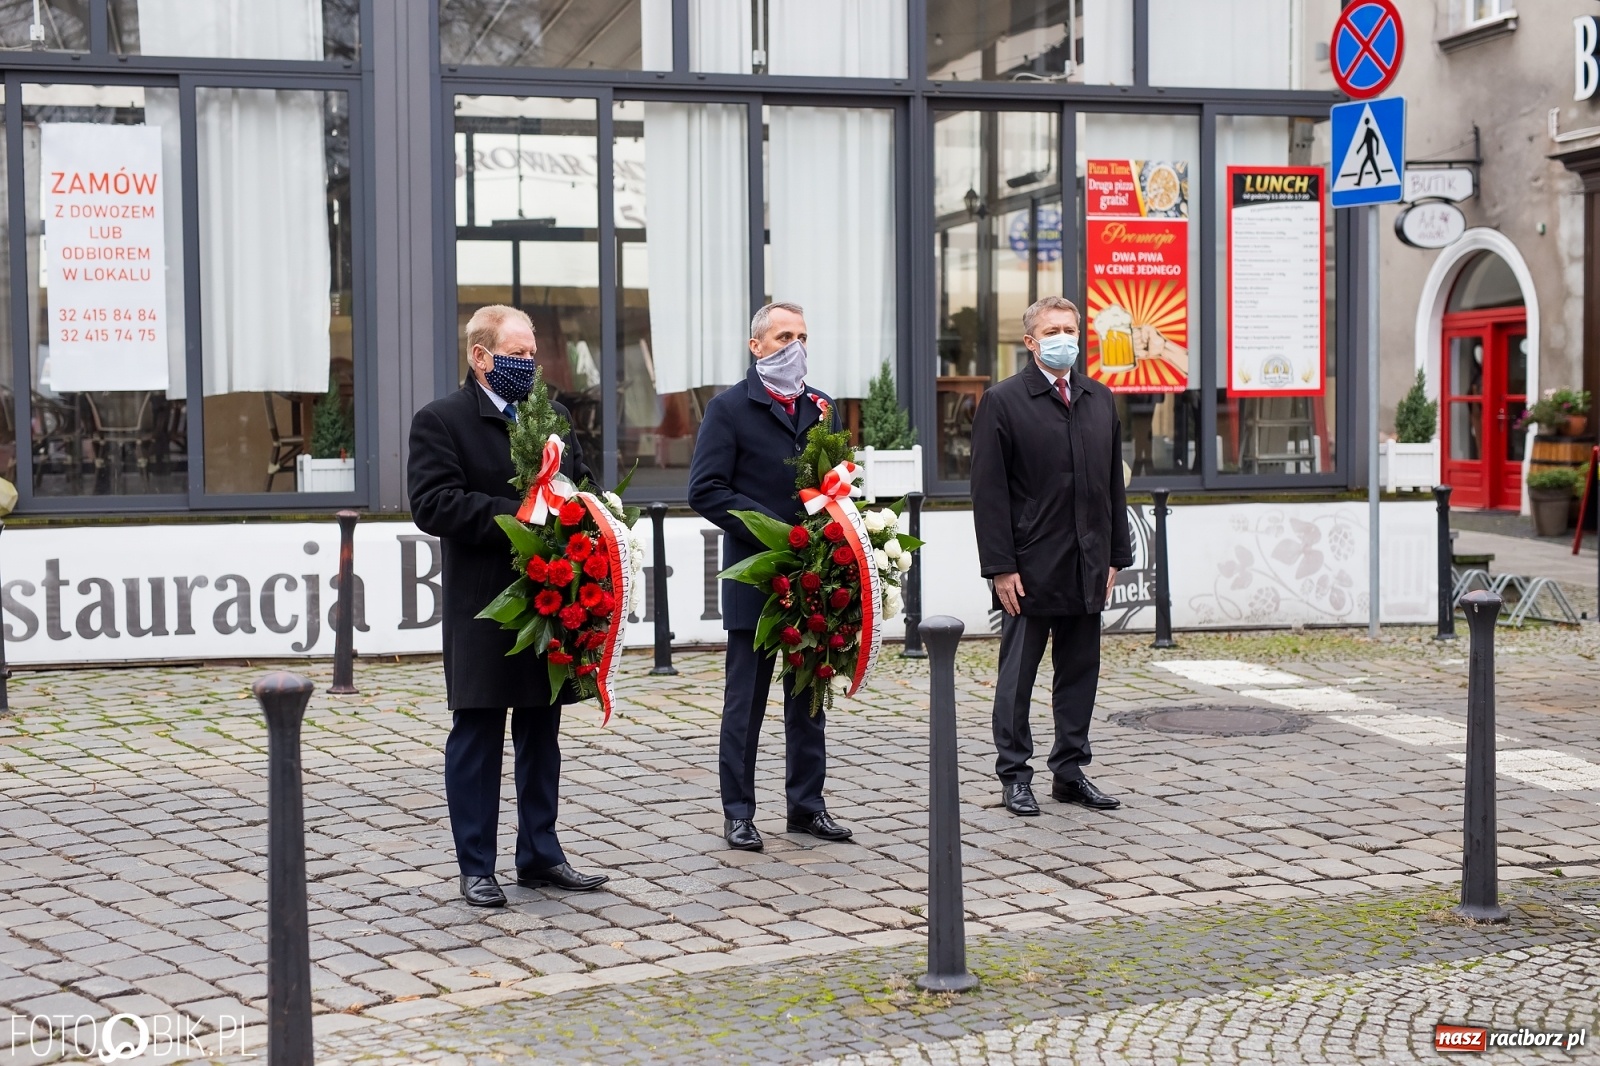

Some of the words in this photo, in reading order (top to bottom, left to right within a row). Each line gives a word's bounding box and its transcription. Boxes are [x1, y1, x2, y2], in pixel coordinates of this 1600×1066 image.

[1088, 162, 1109, 175] Pizza
[1109, 162, 1131, 175] Time
[51, 167, 157, 195] ZAMÓW
[1088, 178, 1114, 194] Druga
[1115, 178, 1134, 194] pizza
[1245, 174, 1309, 193] LUNCH
[1411, 174, 1457, 195] BUTIK
[1100, 192, 1129, 211] gratis!
[55, 204, 64, 218] Z
[70, 204, 155, 219] DOWOZEM
[89, 226, 122, 239] LUB
[1101, 222, 1176, 250] Promocja
[62, 246, 150, 260] ODBIOREM
[1112, 251, 1136, 263] DWA
[1138, 251, 1164, 263] PIWA
[62, 267, 78, 281] W
[84, 267, 151, 282] LOKALU
[1094, 264, 1105, 275] W
[1106, 264, 1135, 275] CENIE
[1136, 264, 1182, 276] JEDNEGO
[59, 308, 77, 322] 32
[83, 308, 107, 322] 415
[113, 308, 132, 322] 84
[138, 308, 157, 322] 84
[61, 329, 79, 342] 32
[85, 329, 109, 342] 415
[115, 329, 133, 342] 74
[138, 329, 156, 342] 75
[856, 532, 881, 620] PREZYDENTA
[1105, 571, 1151, 611] ynek
